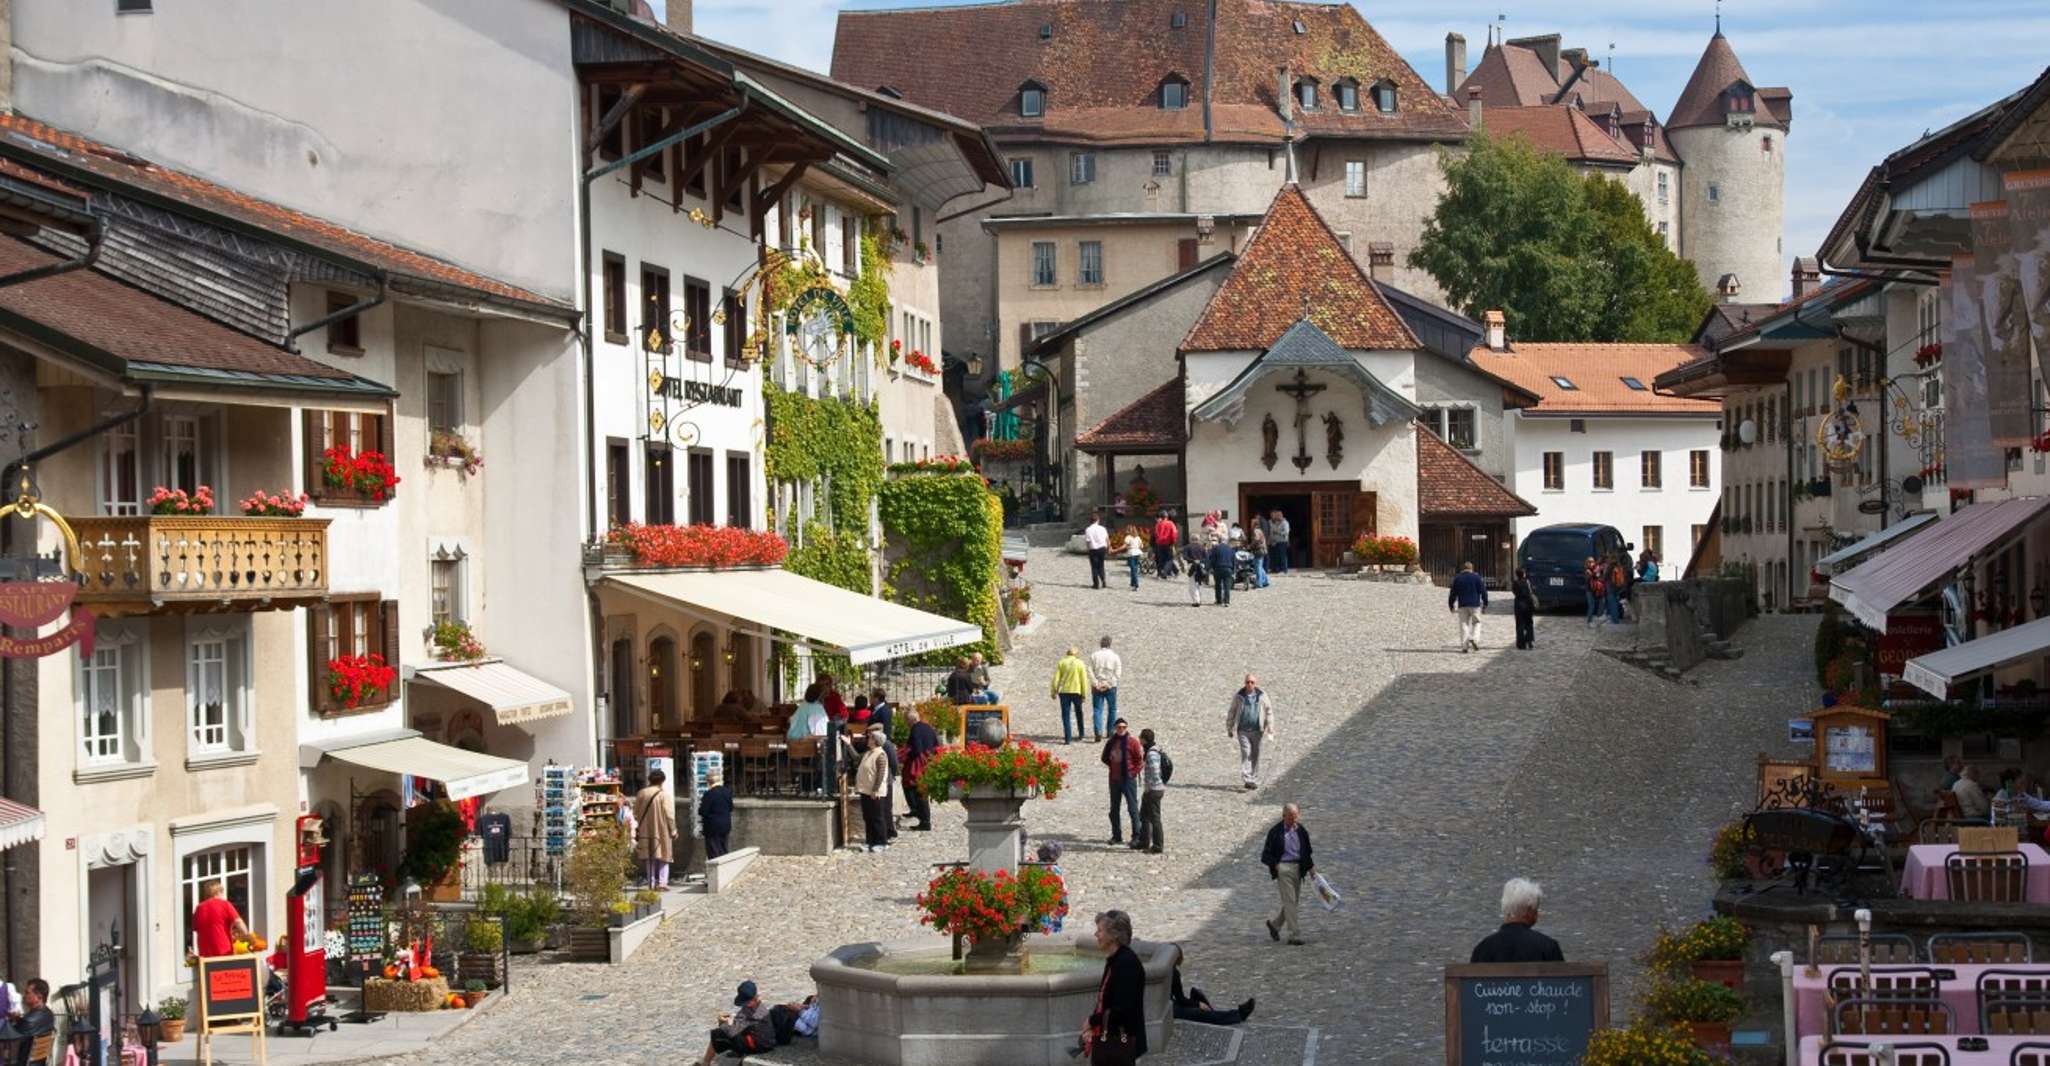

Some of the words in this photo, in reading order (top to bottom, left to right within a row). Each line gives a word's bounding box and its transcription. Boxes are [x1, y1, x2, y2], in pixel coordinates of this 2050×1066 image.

[684, 380, 743, 408] RESTAURANT
[0, 622, 86, 655] Remparts
[934, 633, 955, 648] VILLE
[1529, 980, 1583, 998] chaude
[1481, 1024, 1570, 1054] terrasse
